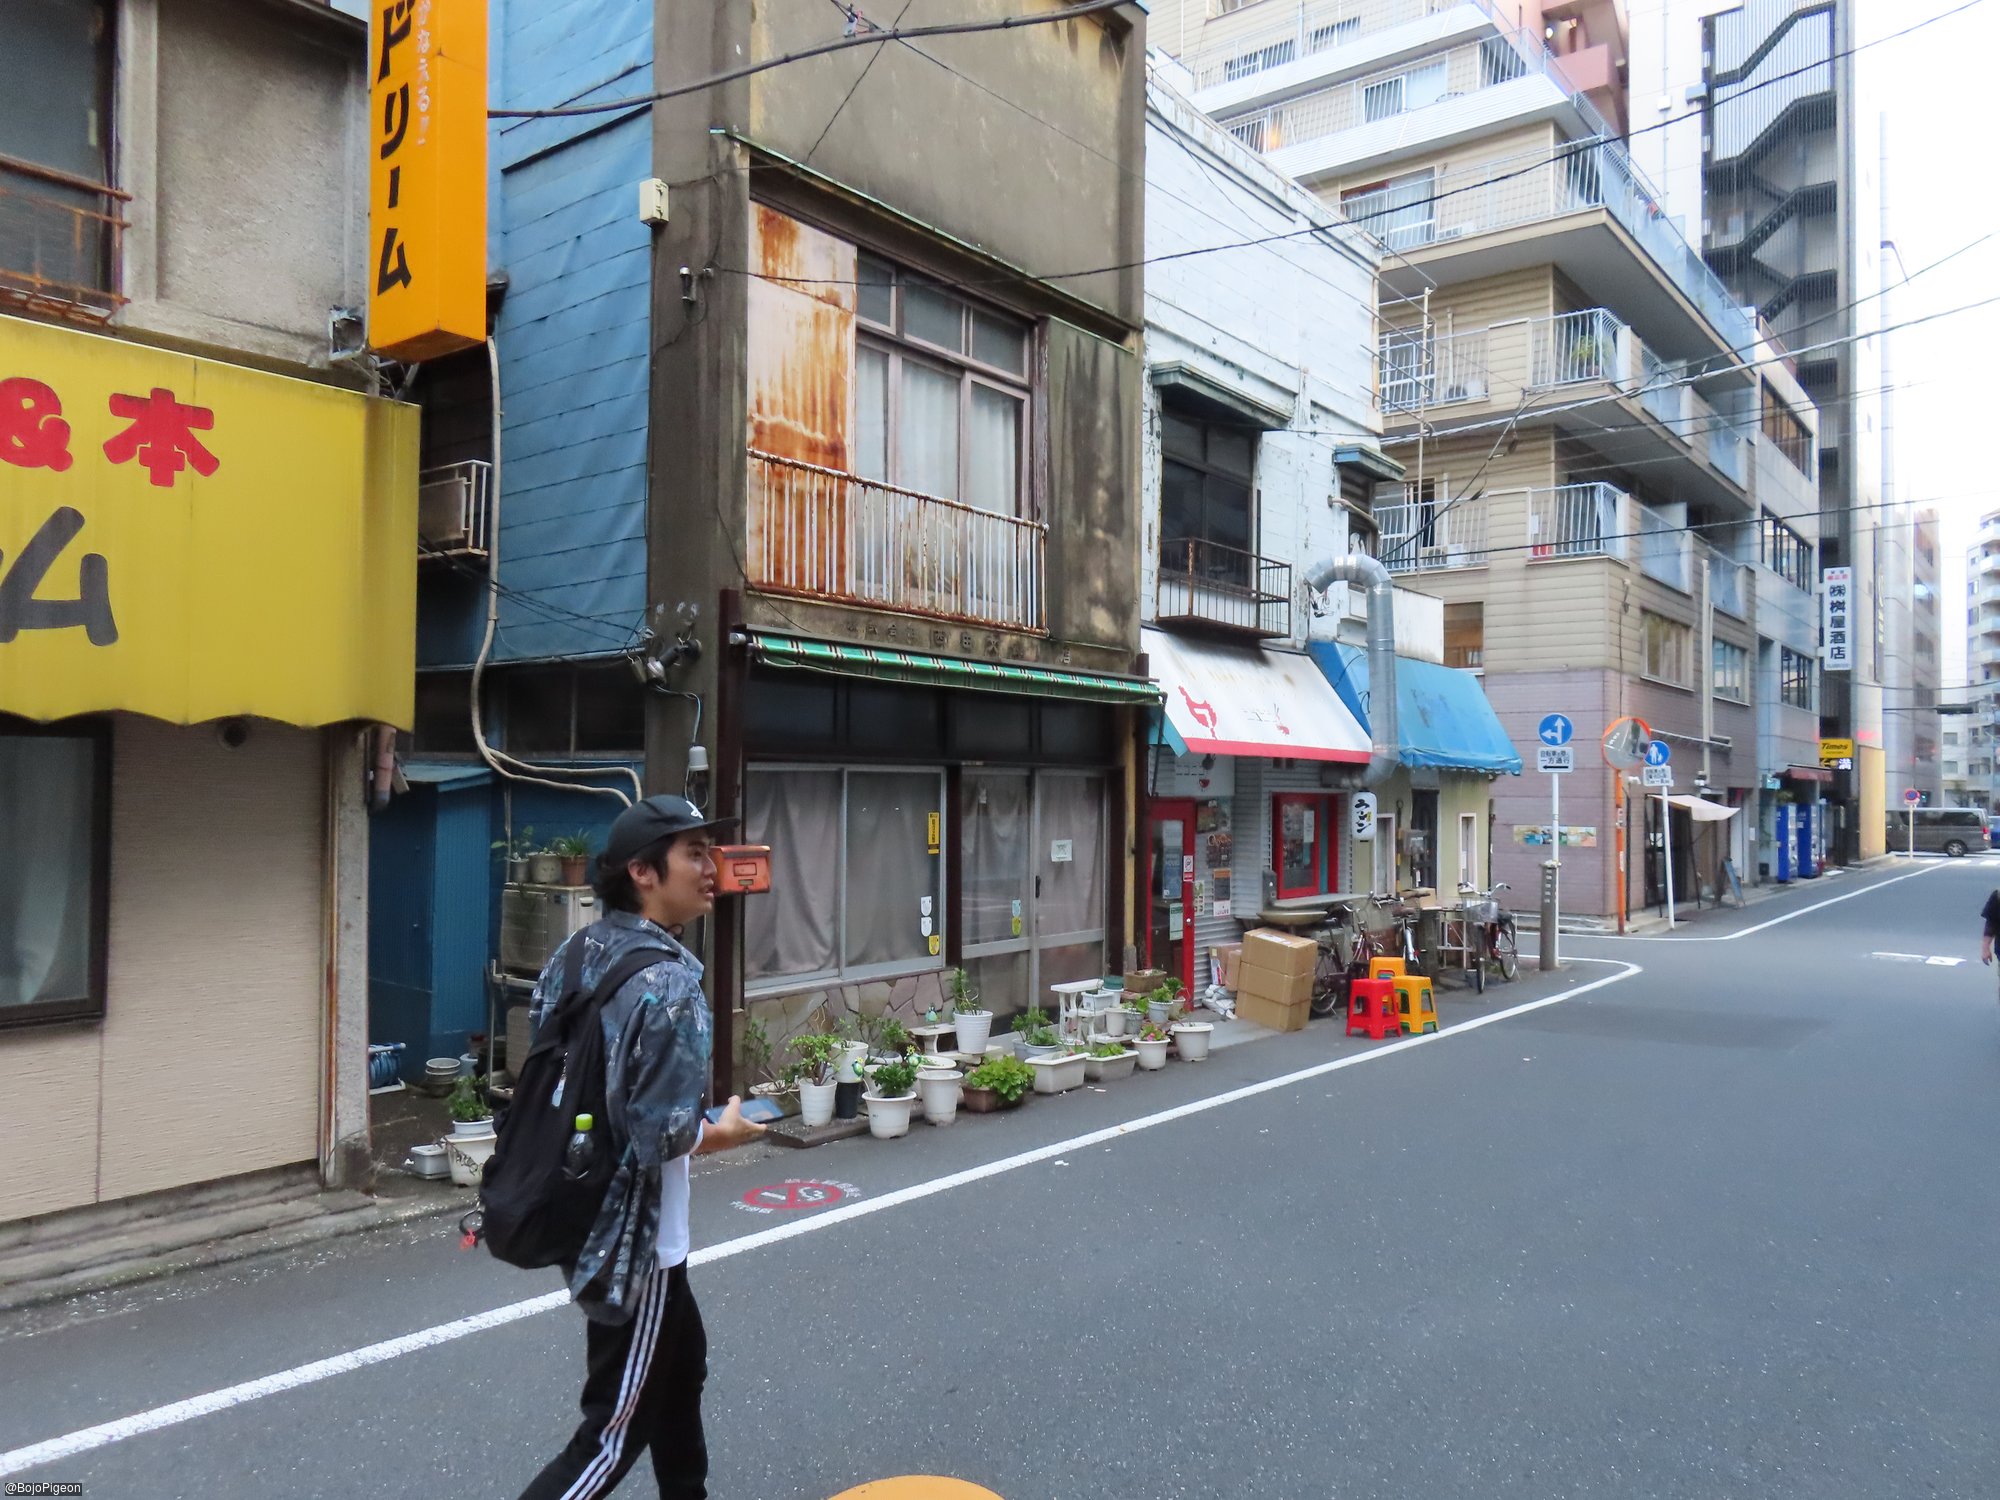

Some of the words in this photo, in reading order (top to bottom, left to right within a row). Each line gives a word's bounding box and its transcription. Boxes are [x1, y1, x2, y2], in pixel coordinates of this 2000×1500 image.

[377, 0, 412, 297] ドリーム
[1822, 742, 1849, 750] Times
